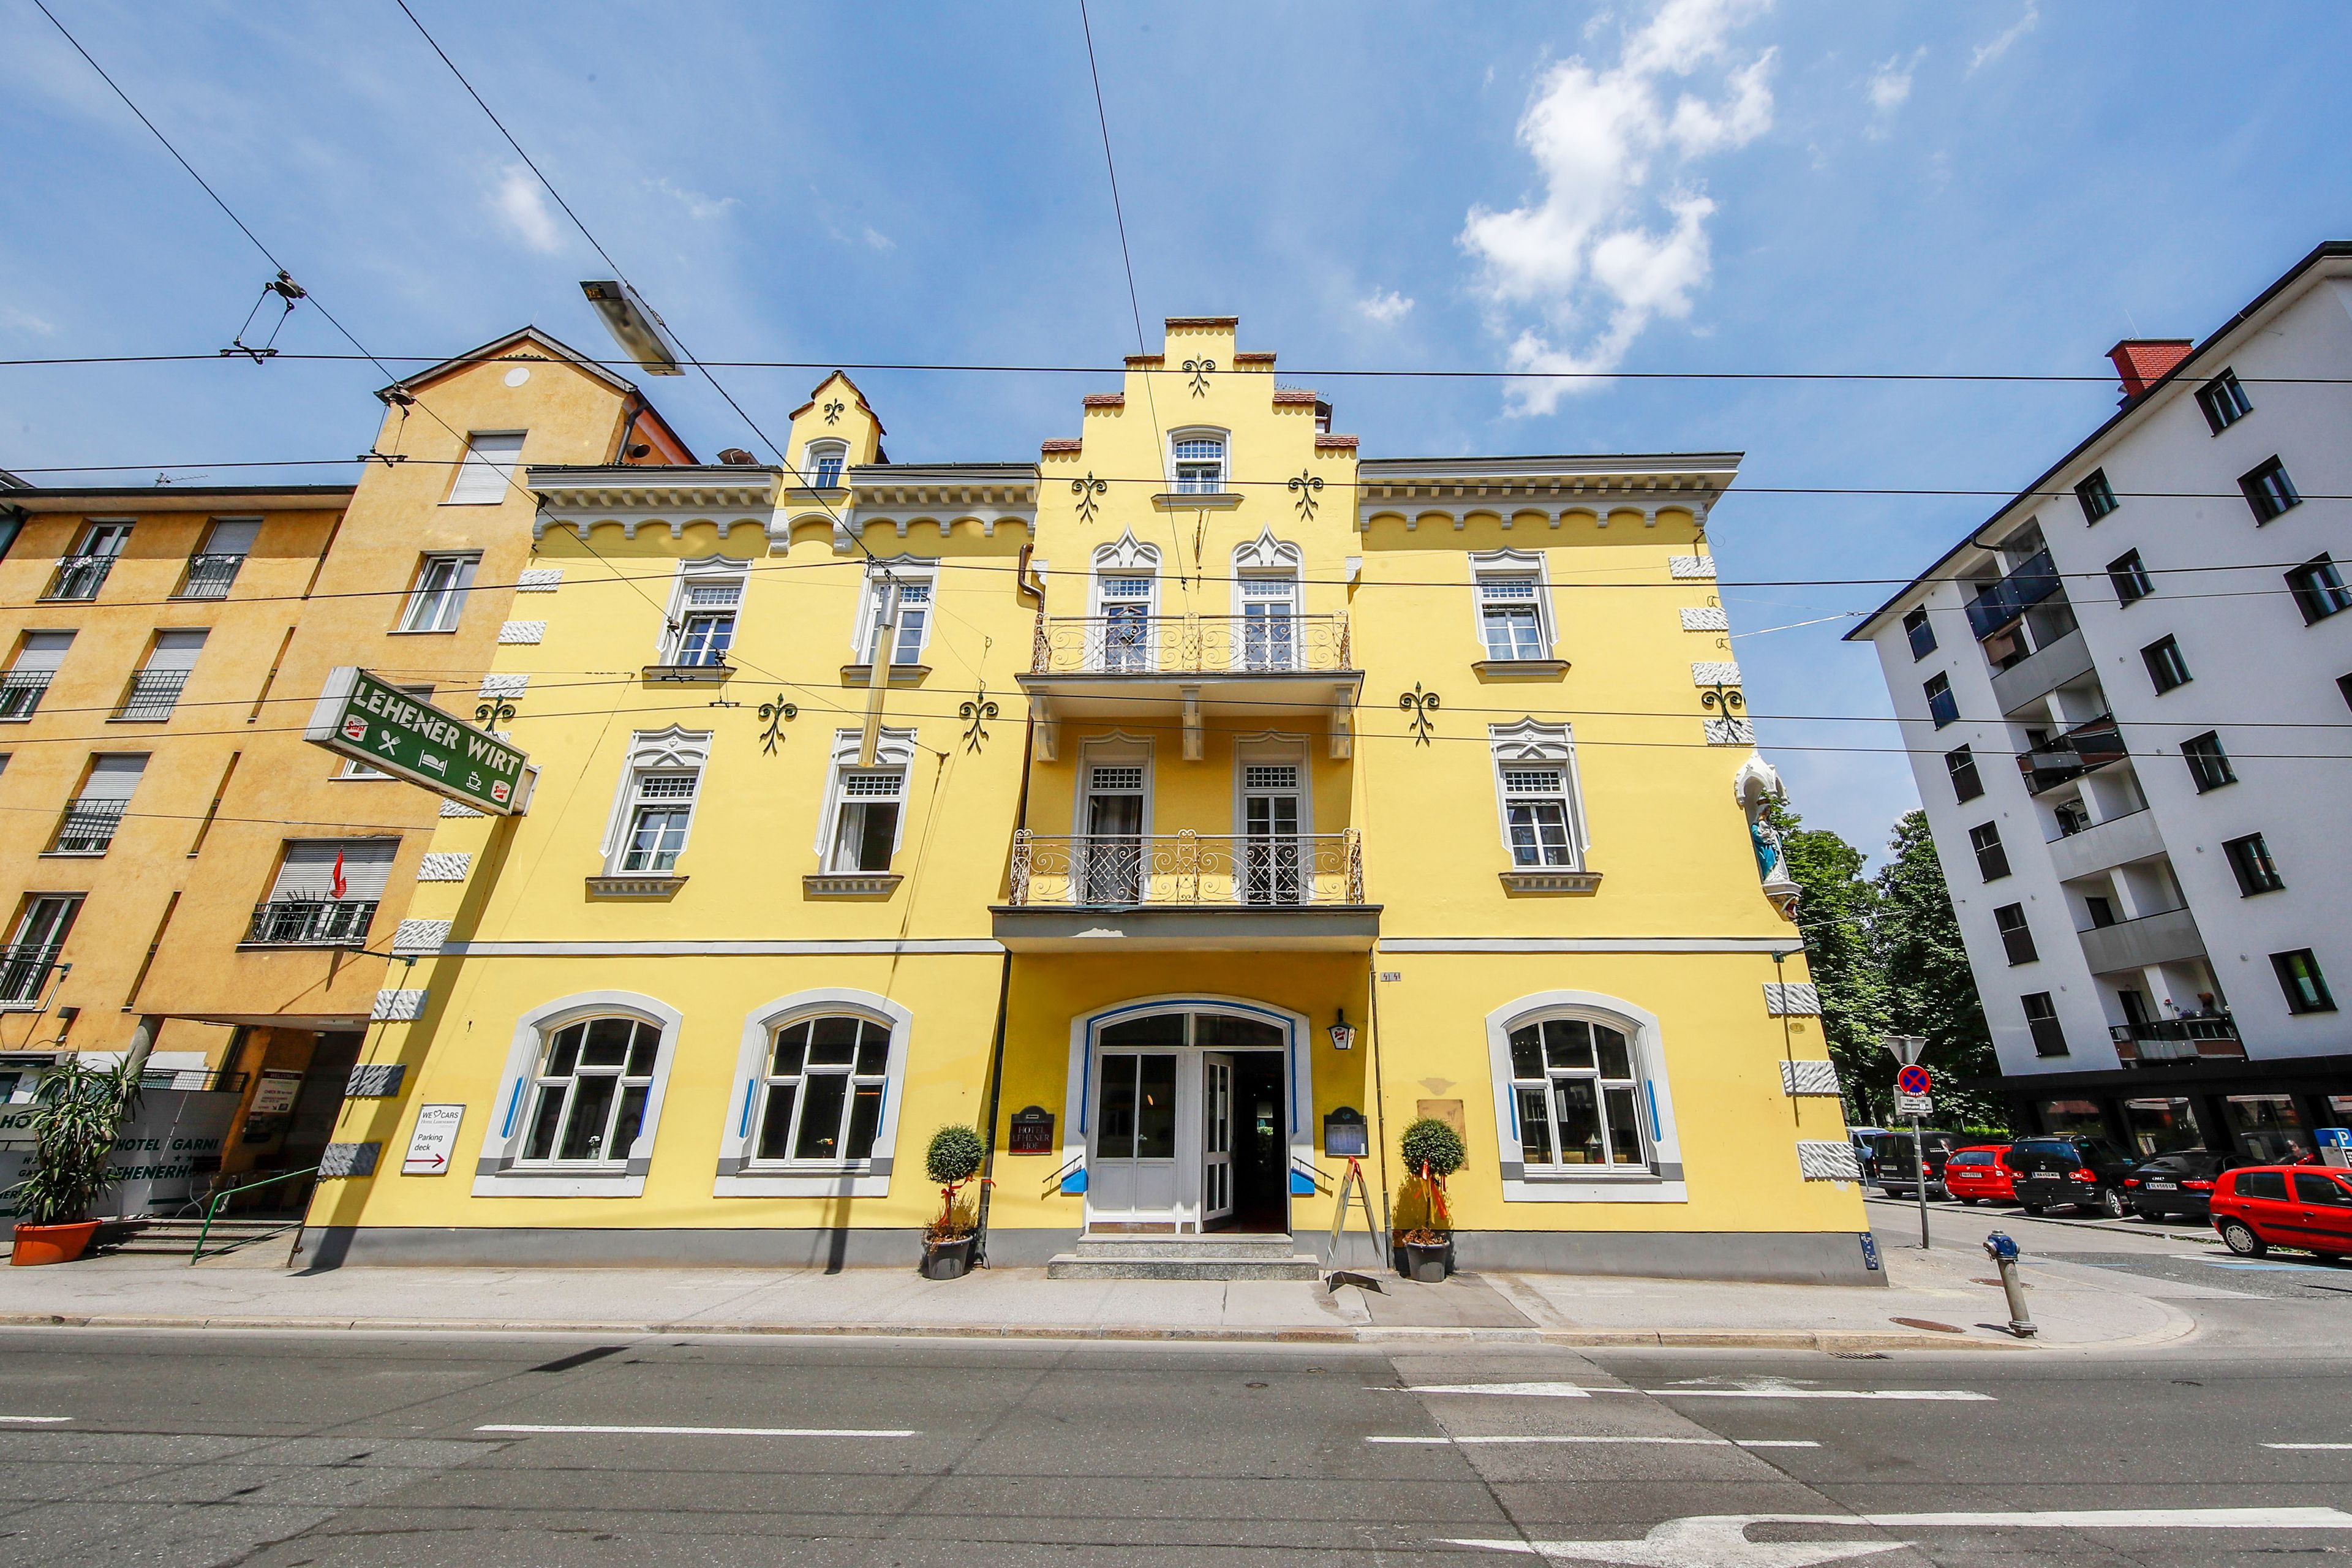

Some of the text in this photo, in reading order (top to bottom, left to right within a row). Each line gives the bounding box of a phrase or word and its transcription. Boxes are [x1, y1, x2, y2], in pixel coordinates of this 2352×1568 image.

[353, 682, 520, 775] LEHENER WIRT
[115, 1138, 219, 1152] HOTEL GARNI
[418, 1134, 443, 1142] Parking
[2337, 1131, 2349, 1146] P
